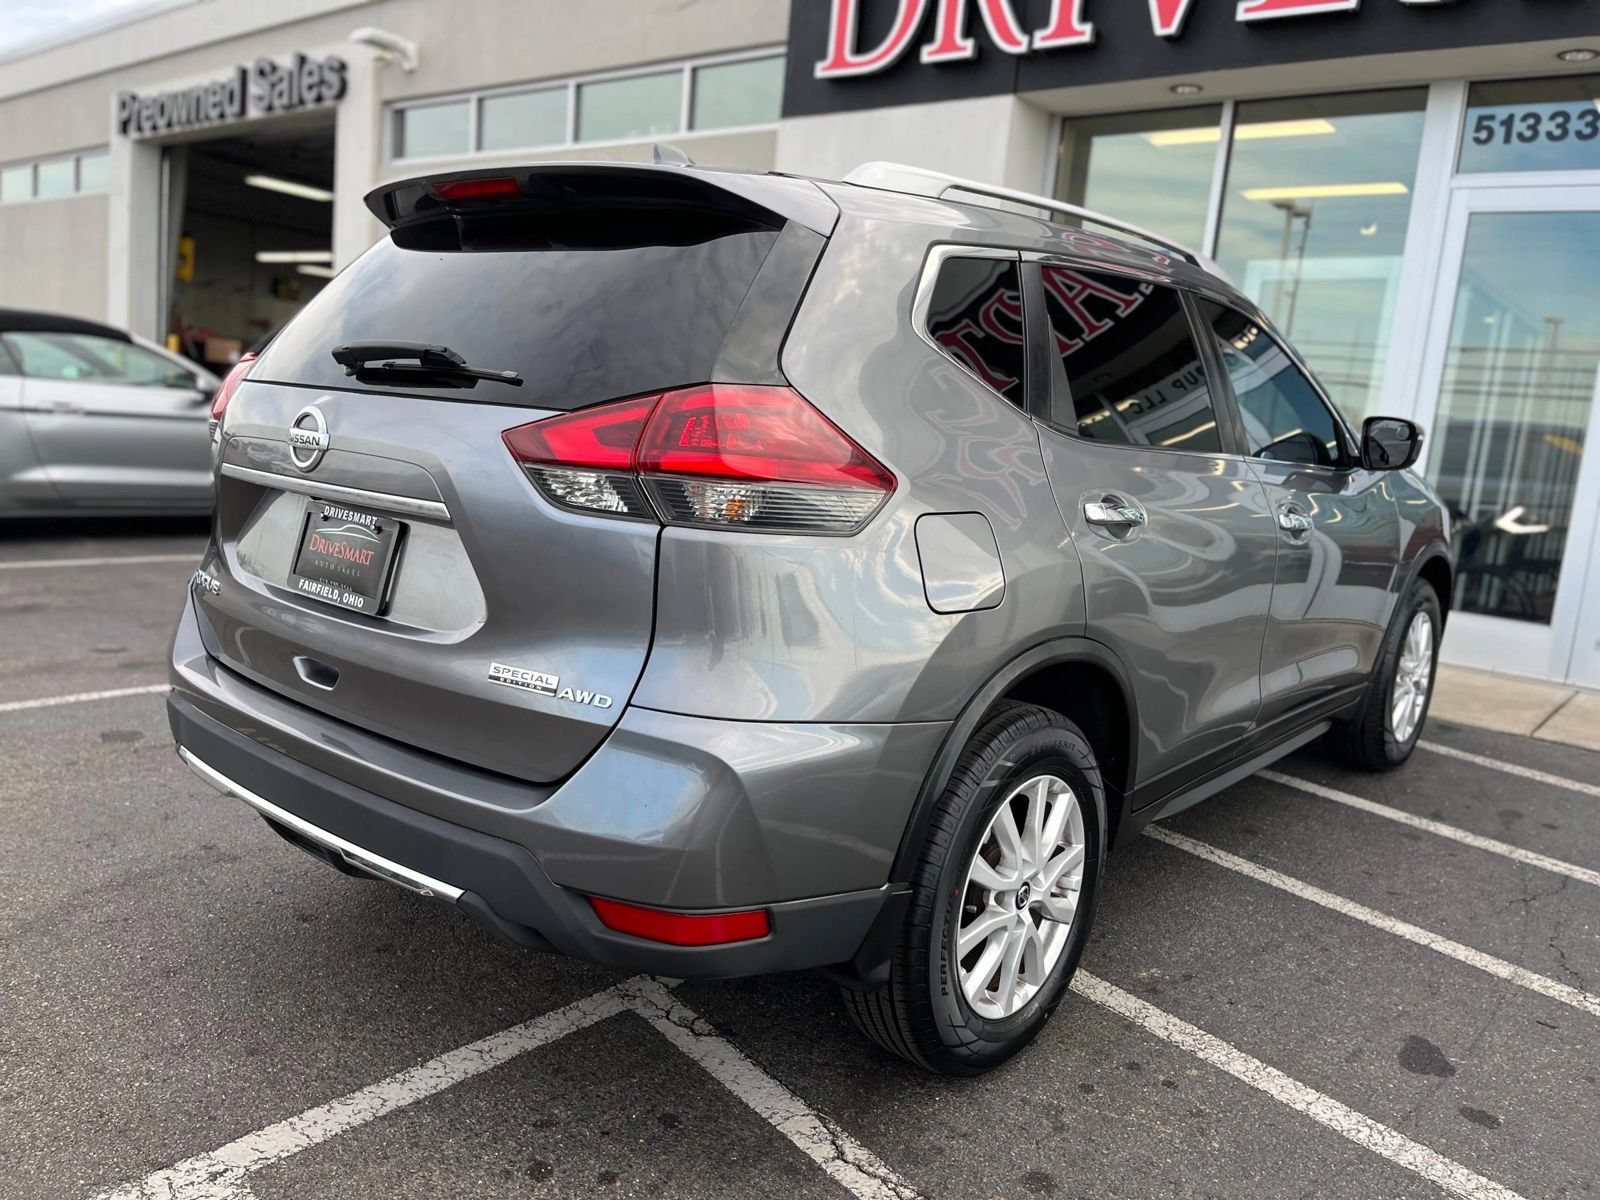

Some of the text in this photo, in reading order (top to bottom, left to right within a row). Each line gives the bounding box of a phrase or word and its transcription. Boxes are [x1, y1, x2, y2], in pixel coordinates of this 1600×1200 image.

[118, 52, 349, 135] Preowned Sales
[1472, 108, 1600, 146] 51333
[324, 505, 378, 527] DRIVESMART
[298, 578, 341, 603] FAIRFIELD,
[342, 592, 364, 608] OHIO
[493, 666, 553, 686] SPECIAL
[557, 687, 614, 709] AWD
